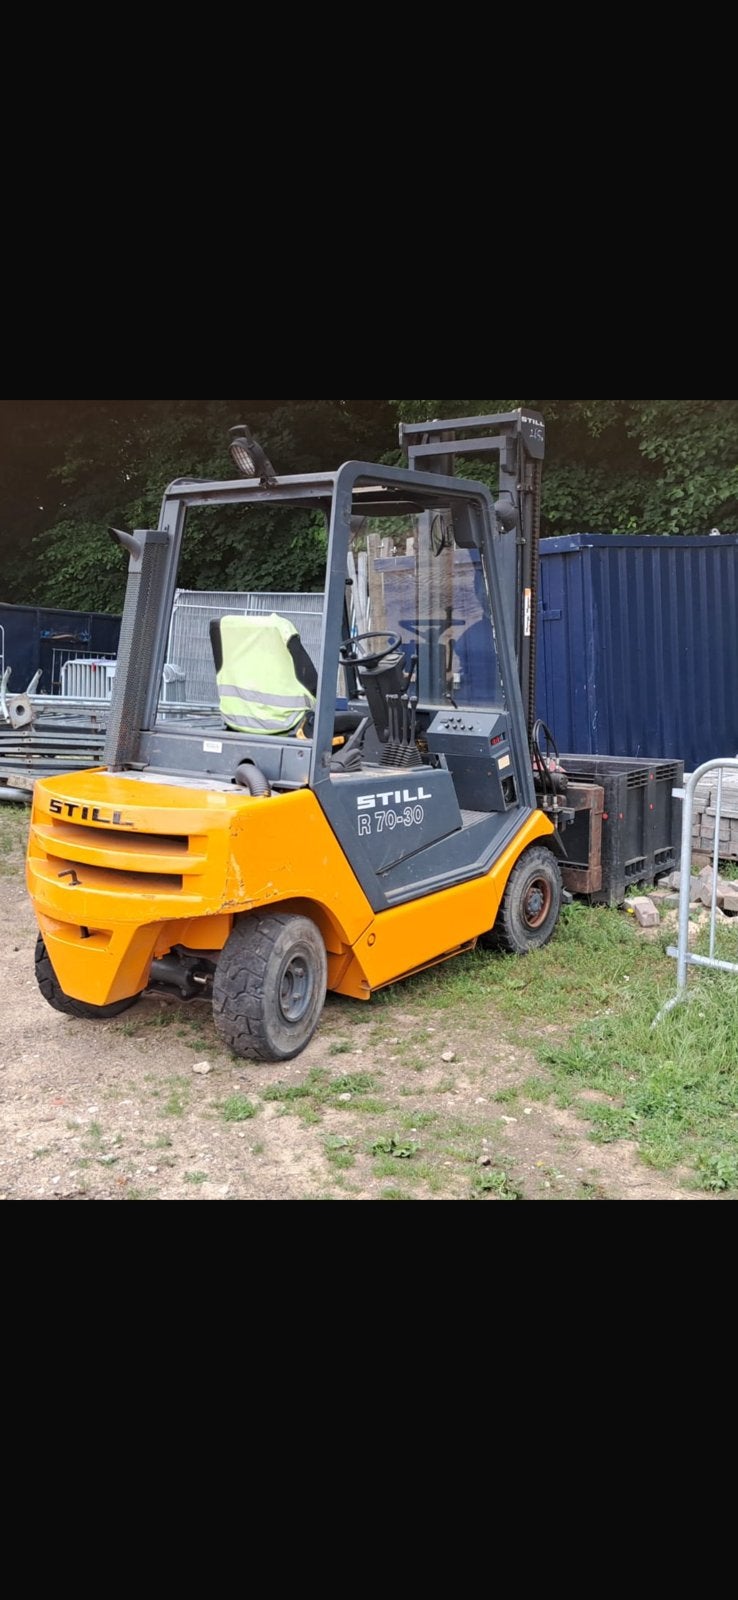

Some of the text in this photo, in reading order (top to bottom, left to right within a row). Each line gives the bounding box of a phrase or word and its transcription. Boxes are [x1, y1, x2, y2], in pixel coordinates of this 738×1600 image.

[521, 416, 545, 427] STILL
[357, 787, 432, 810] STILL
[49, 799, 134, 826] STILL
[357, 804, 424, 836] R 70-30
